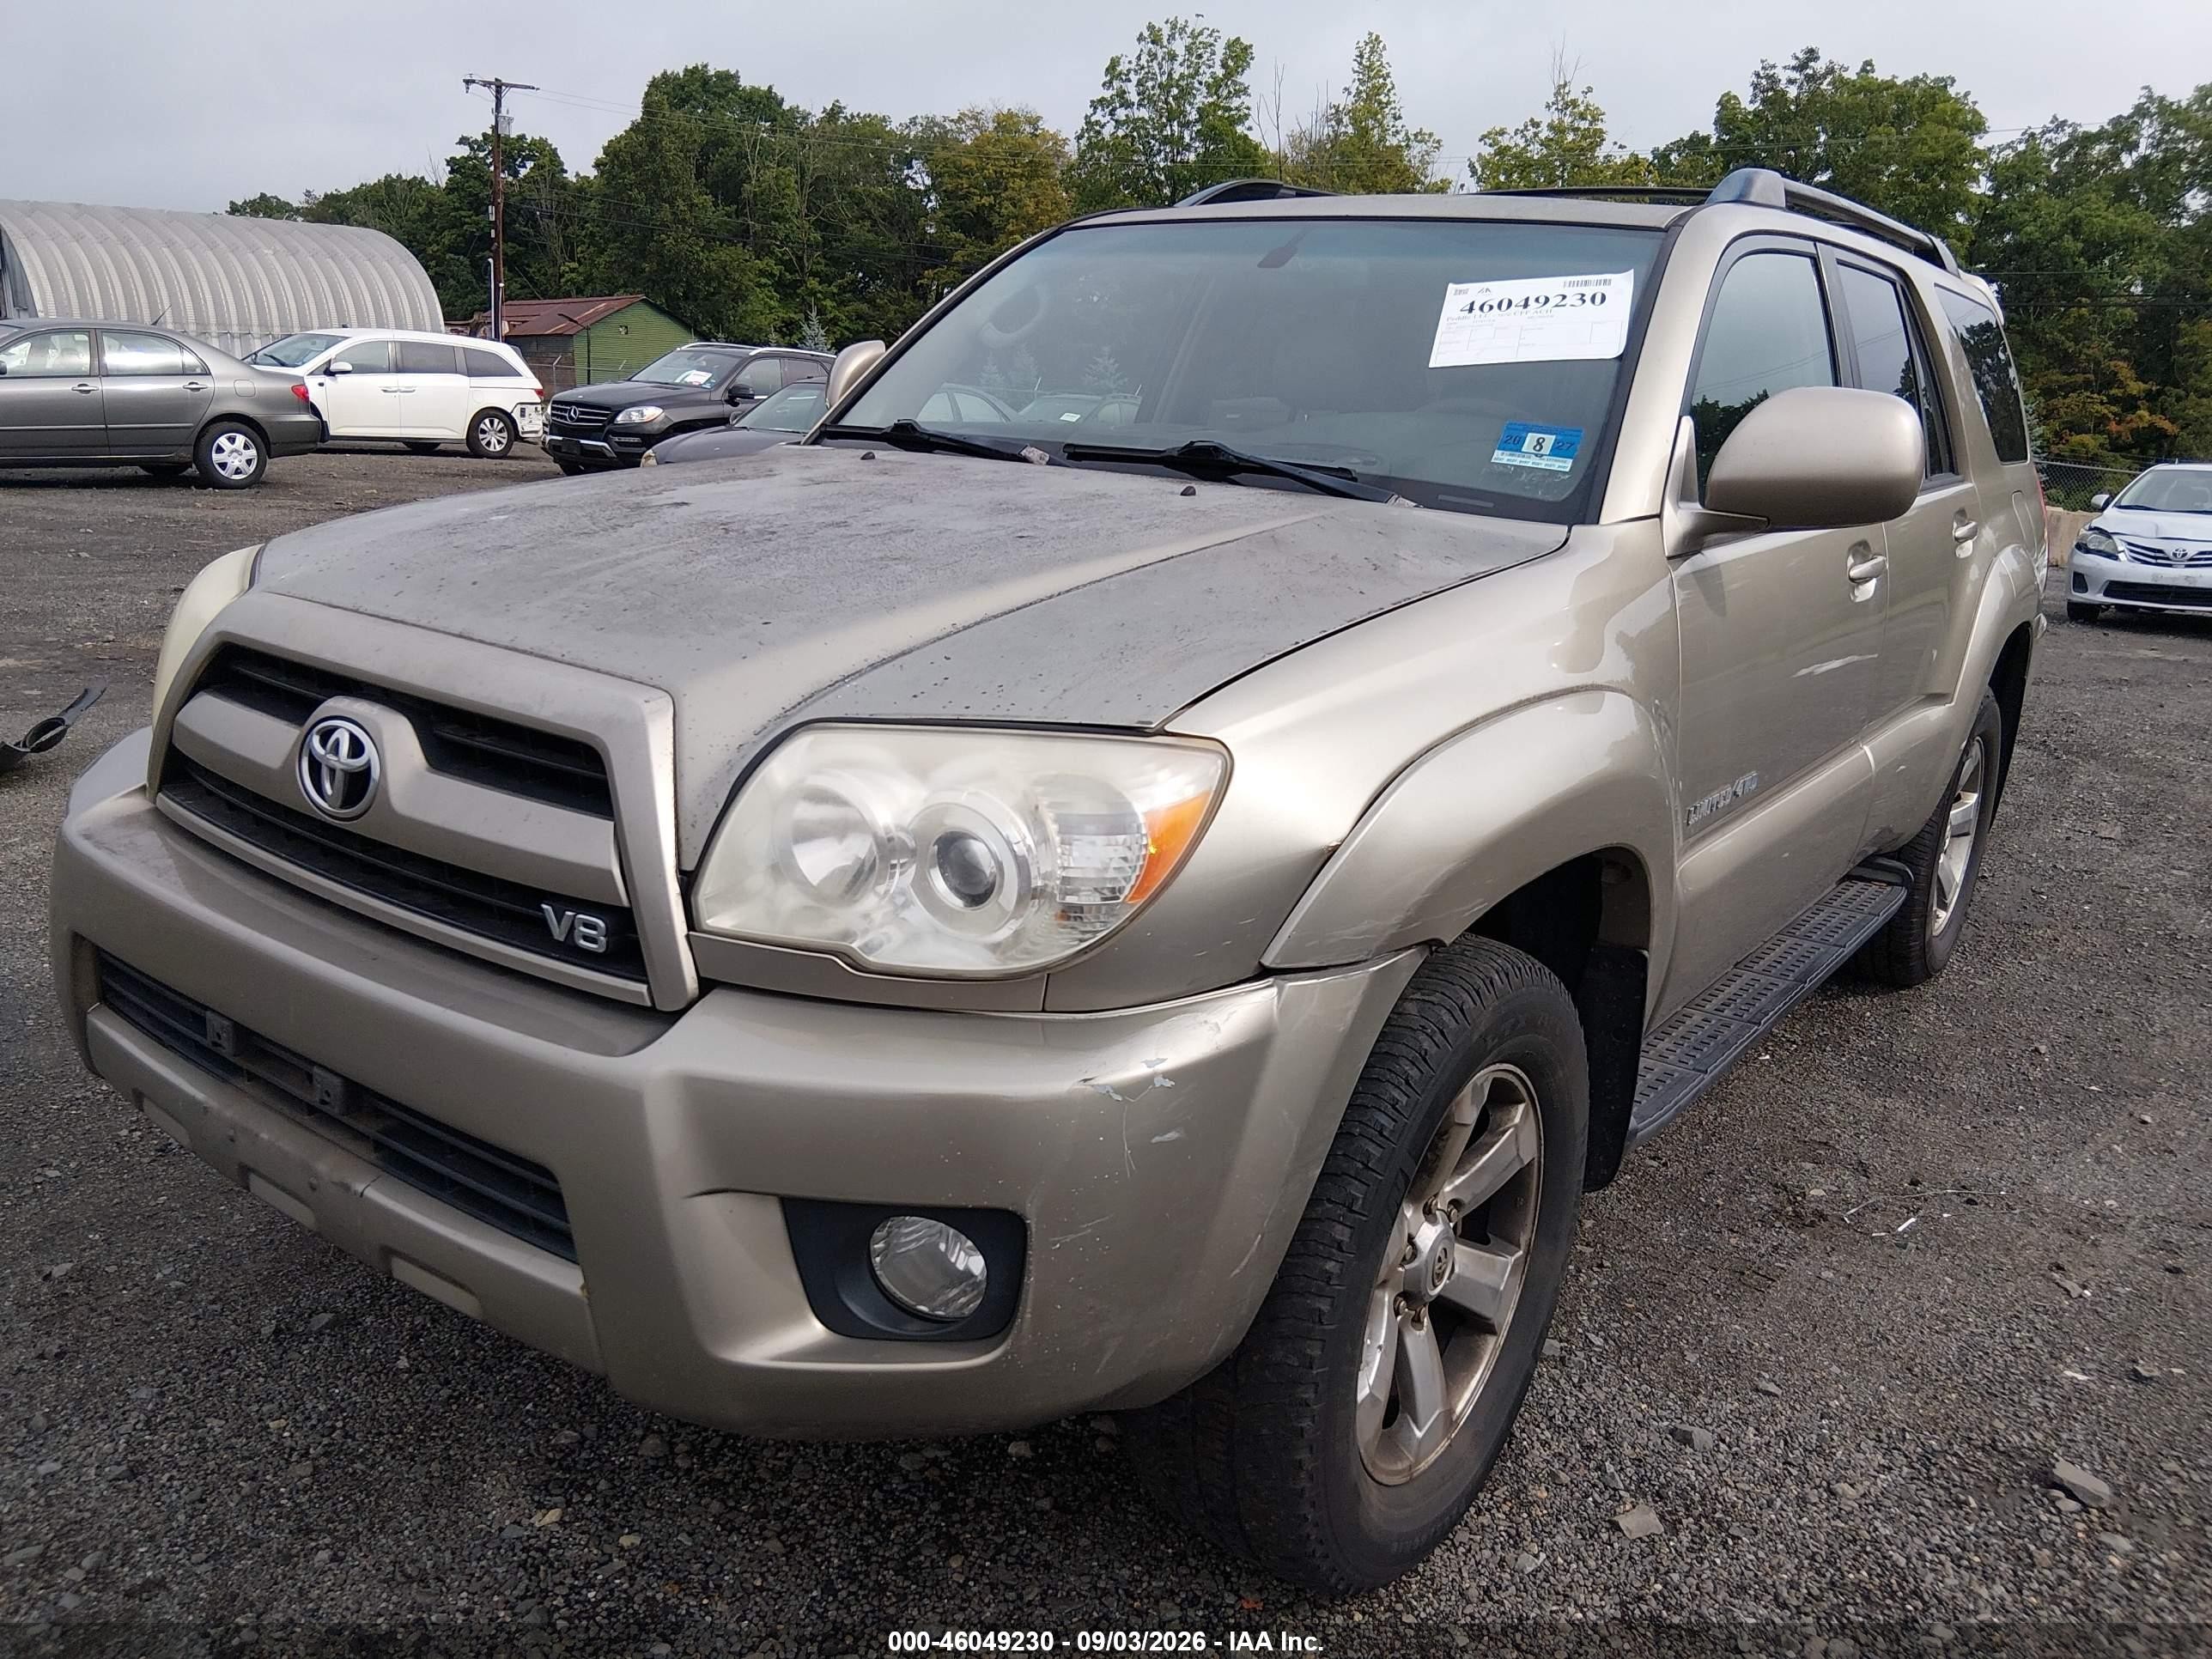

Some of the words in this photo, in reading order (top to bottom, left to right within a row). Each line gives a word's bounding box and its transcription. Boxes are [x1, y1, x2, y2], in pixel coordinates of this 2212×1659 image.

[1460, 291, 1607, 314] 46049230
[1533, 436, 1546, 452] 8
[1554, 441, 1576, 452] 27
[540, 903, 607, 953] V8
